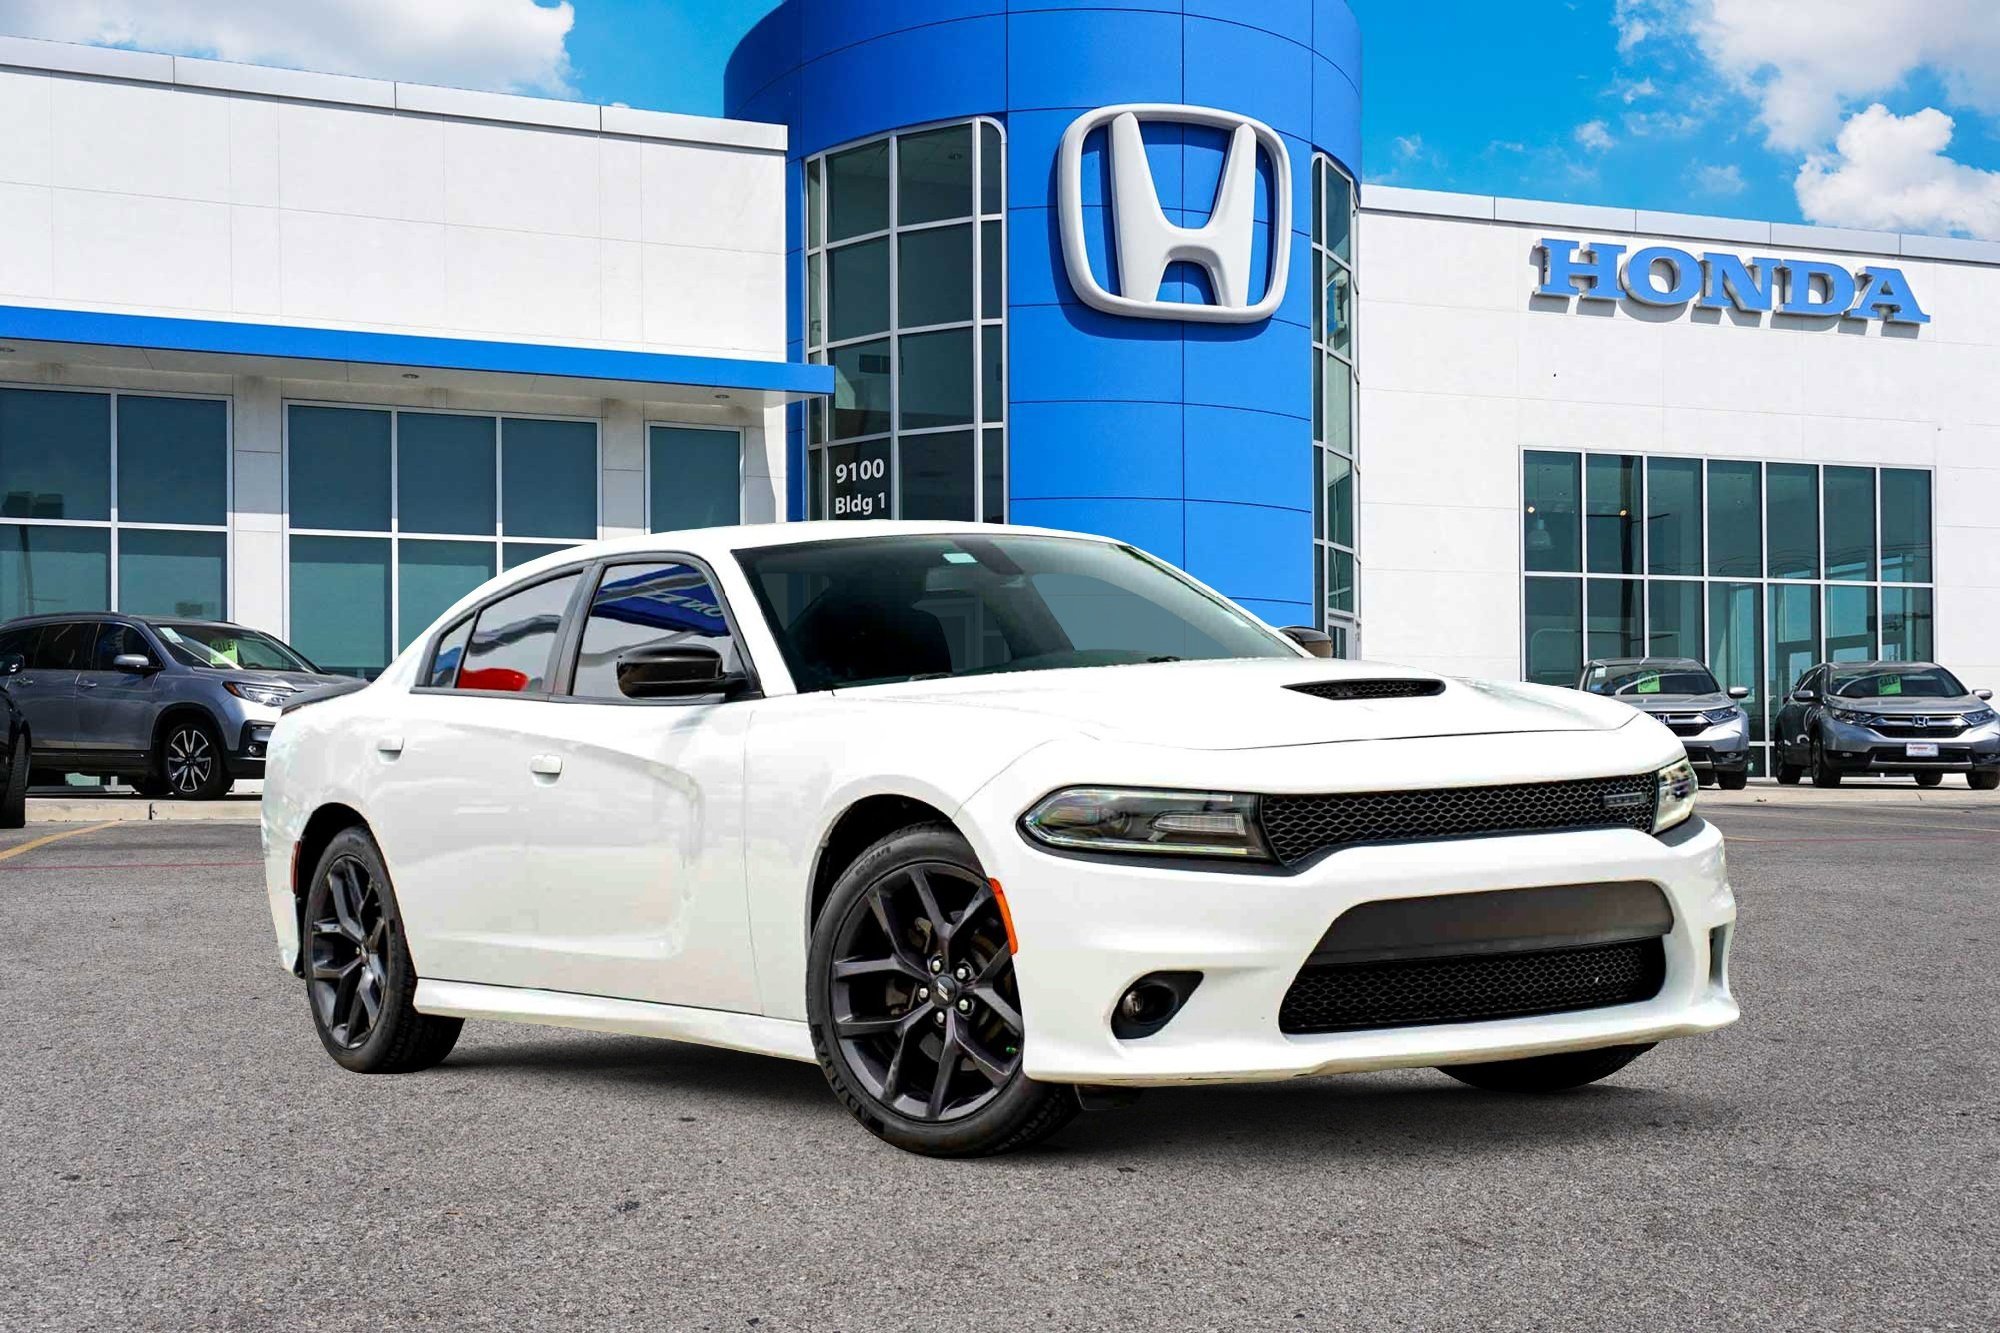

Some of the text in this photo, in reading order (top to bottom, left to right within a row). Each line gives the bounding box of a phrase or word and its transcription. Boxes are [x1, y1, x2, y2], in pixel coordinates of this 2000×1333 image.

[1535, 237, 1931, 323] HONDA
[835, 458, 885, 484] 9100
[835, 492, 886, 515] Bldg 1
